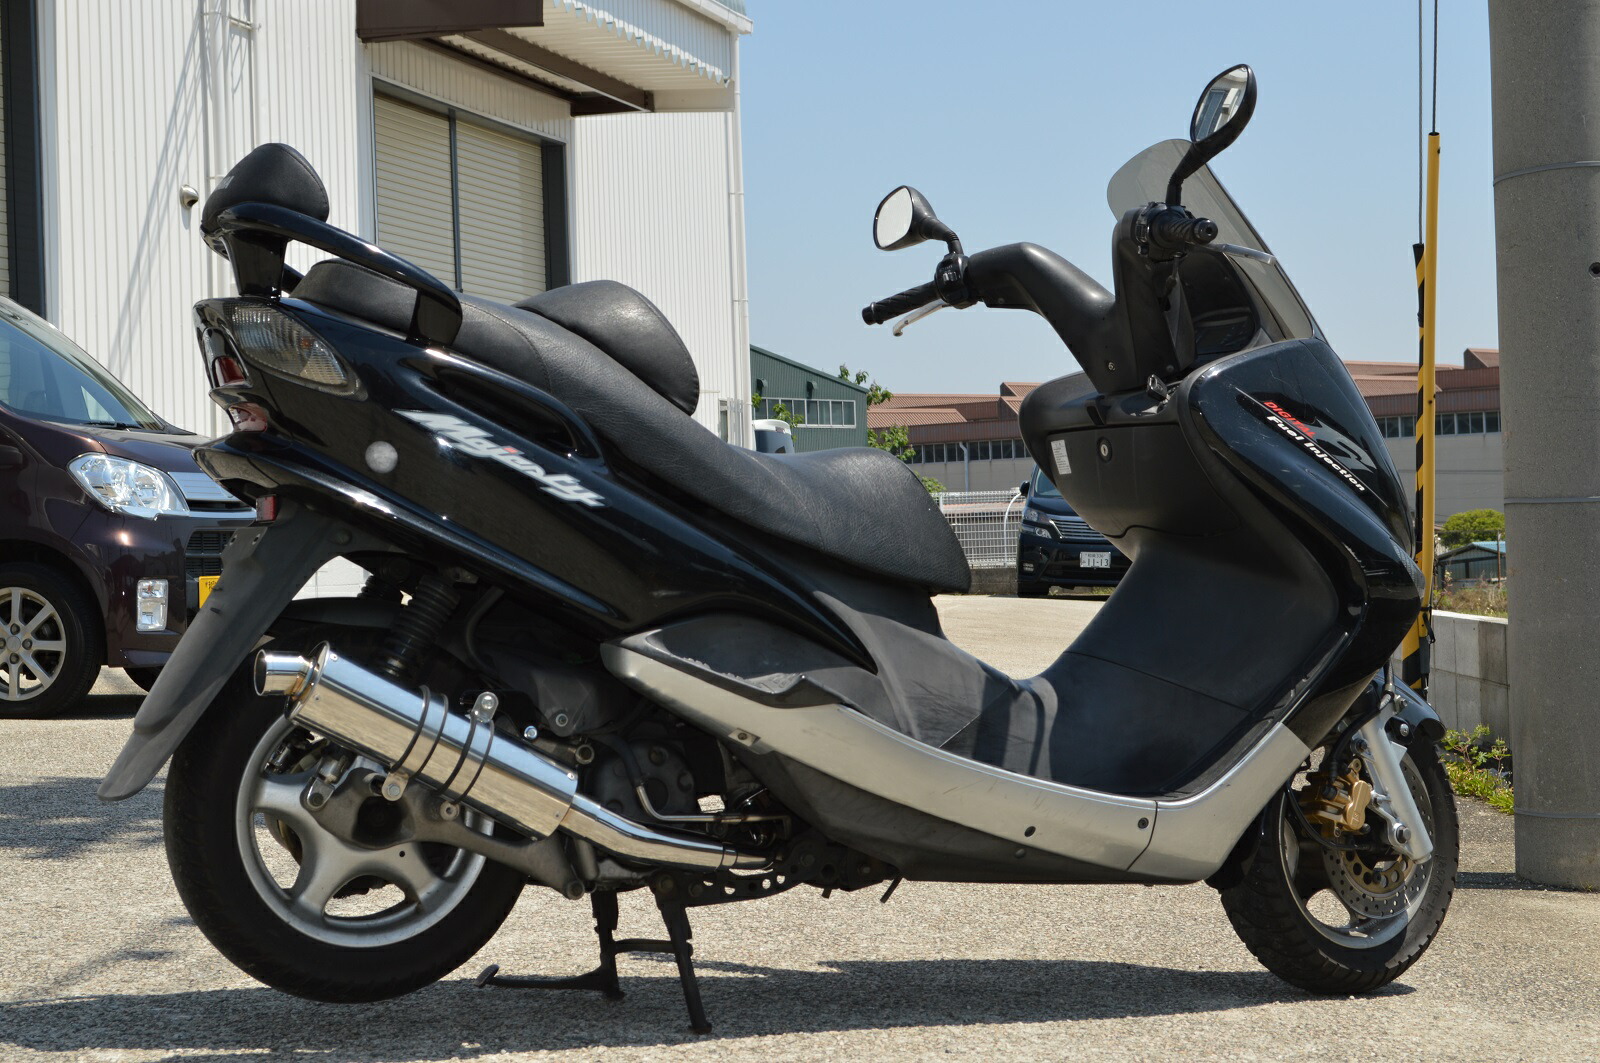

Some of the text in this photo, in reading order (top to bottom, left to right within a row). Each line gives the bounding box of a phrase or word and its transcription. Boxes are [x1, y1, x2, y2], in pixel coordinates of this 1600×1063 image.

[1264, 401, 1316, 438] DIGITAL
[1267, 415, 1365, 491] Fuel Injection
